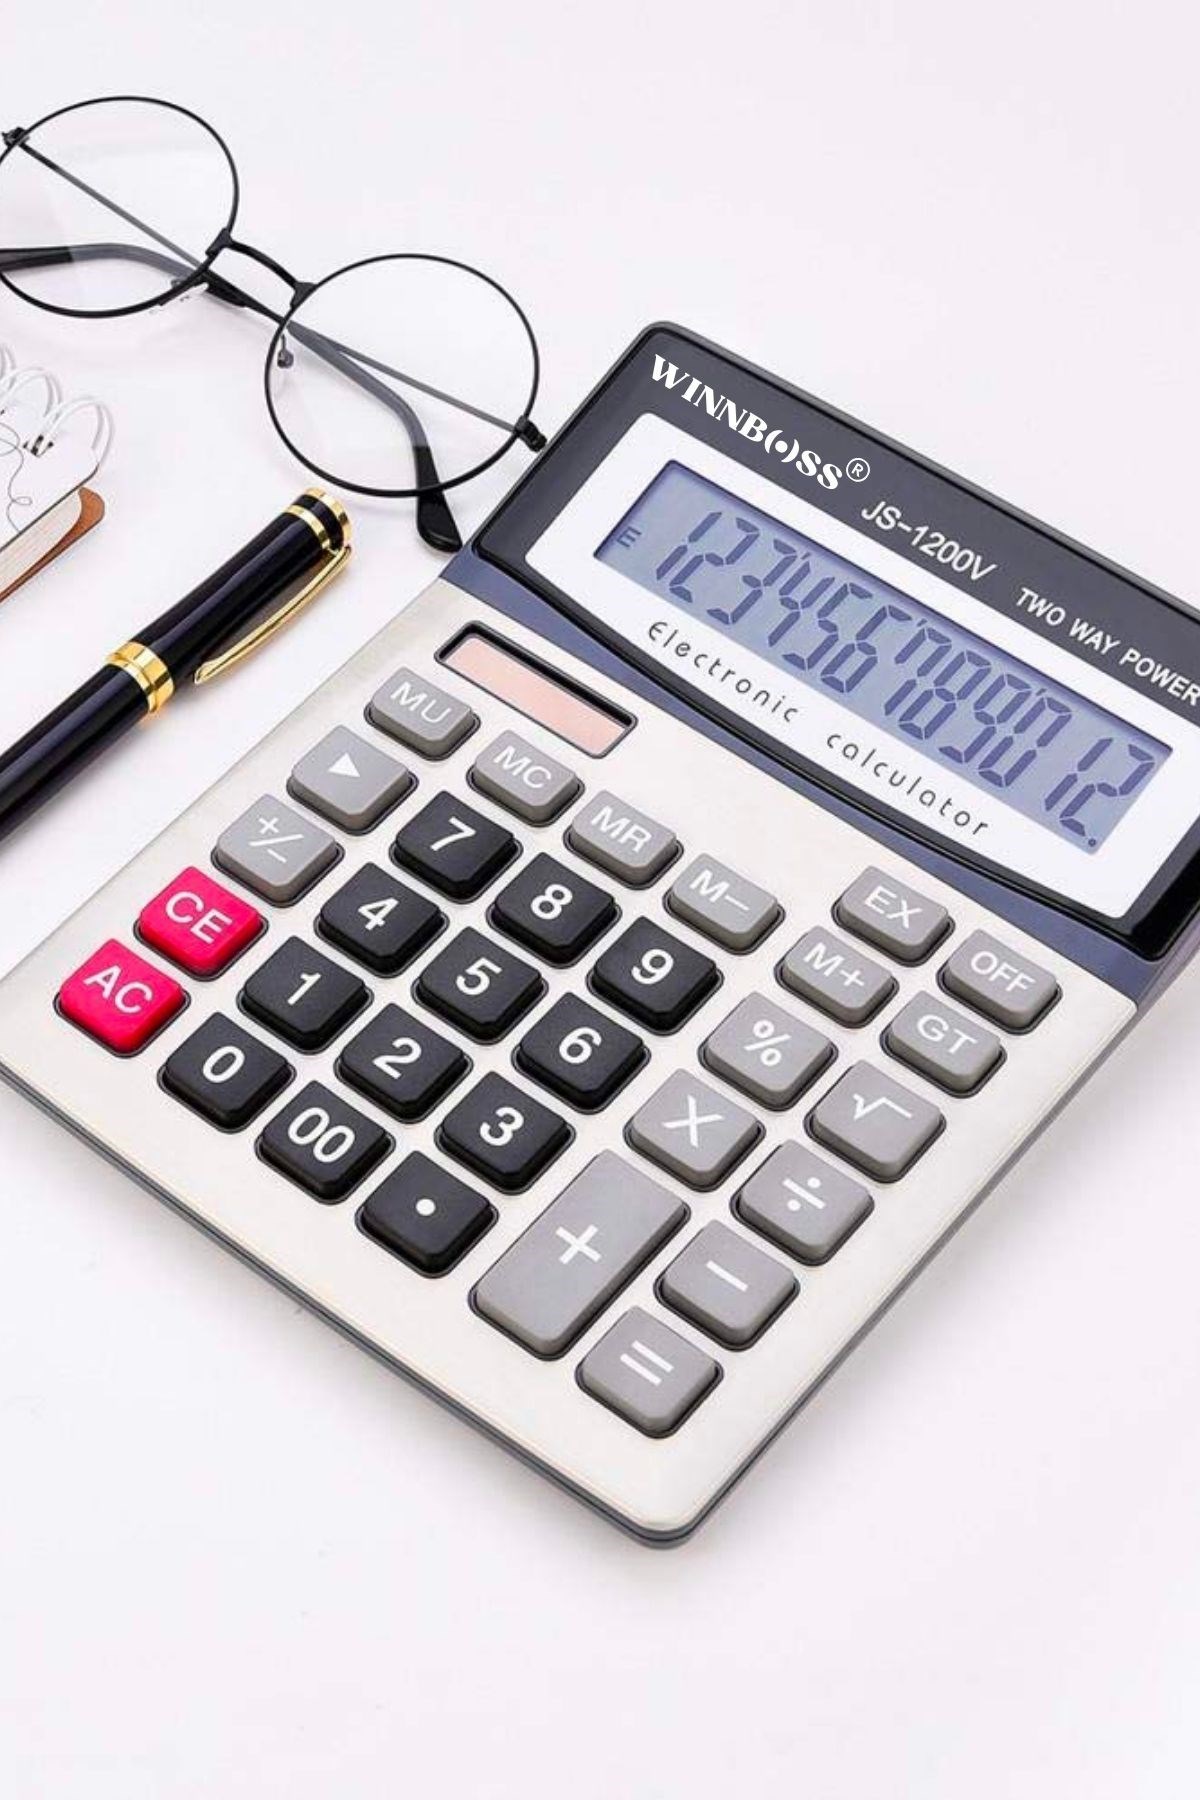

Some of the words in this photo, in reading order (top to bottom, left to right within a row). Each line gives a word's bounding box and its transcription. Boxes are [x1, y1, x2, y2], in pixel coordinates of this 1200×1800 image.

[860, 501, 998, 582] JS-1200V
[1014, 587, 1067, 628] TWO
[1068, 618, 1121, 656] WAY
[1118, 647, 1200, 707] POWER
[390, 681, 454, 724] MU
[493, 744, 553, 789] MC
[826, 732, 990, 837] calculator
[430, 817, 476, 851] 7
[590, 804, 652, 854] MR
[165, 890, 233, 943] CE
[358, 898, 399, 931] 4
[530, 884, 573, 920] 8
[864, 884, 924, 929] EX
[456, 957, 502, 996] 5
[631, 948, 674, 985] 9
[803, 941, 866, 988] M+
[970, 950, 1037, 993] OFF
[83, 964, 153, 1014] AC
[287, 973, 321, 1005] 1
[559, 1027, 602, 1064] 6
[743, 1018, 791, 1068] %
[916, 1012, 978, 1055] GT
[202, 1045, 245, 1083] 0
[373, 1037, 422, 1079] 2
[287, 1105, 356, 1164] 00
[479, 1106, 524, 1146] 3
